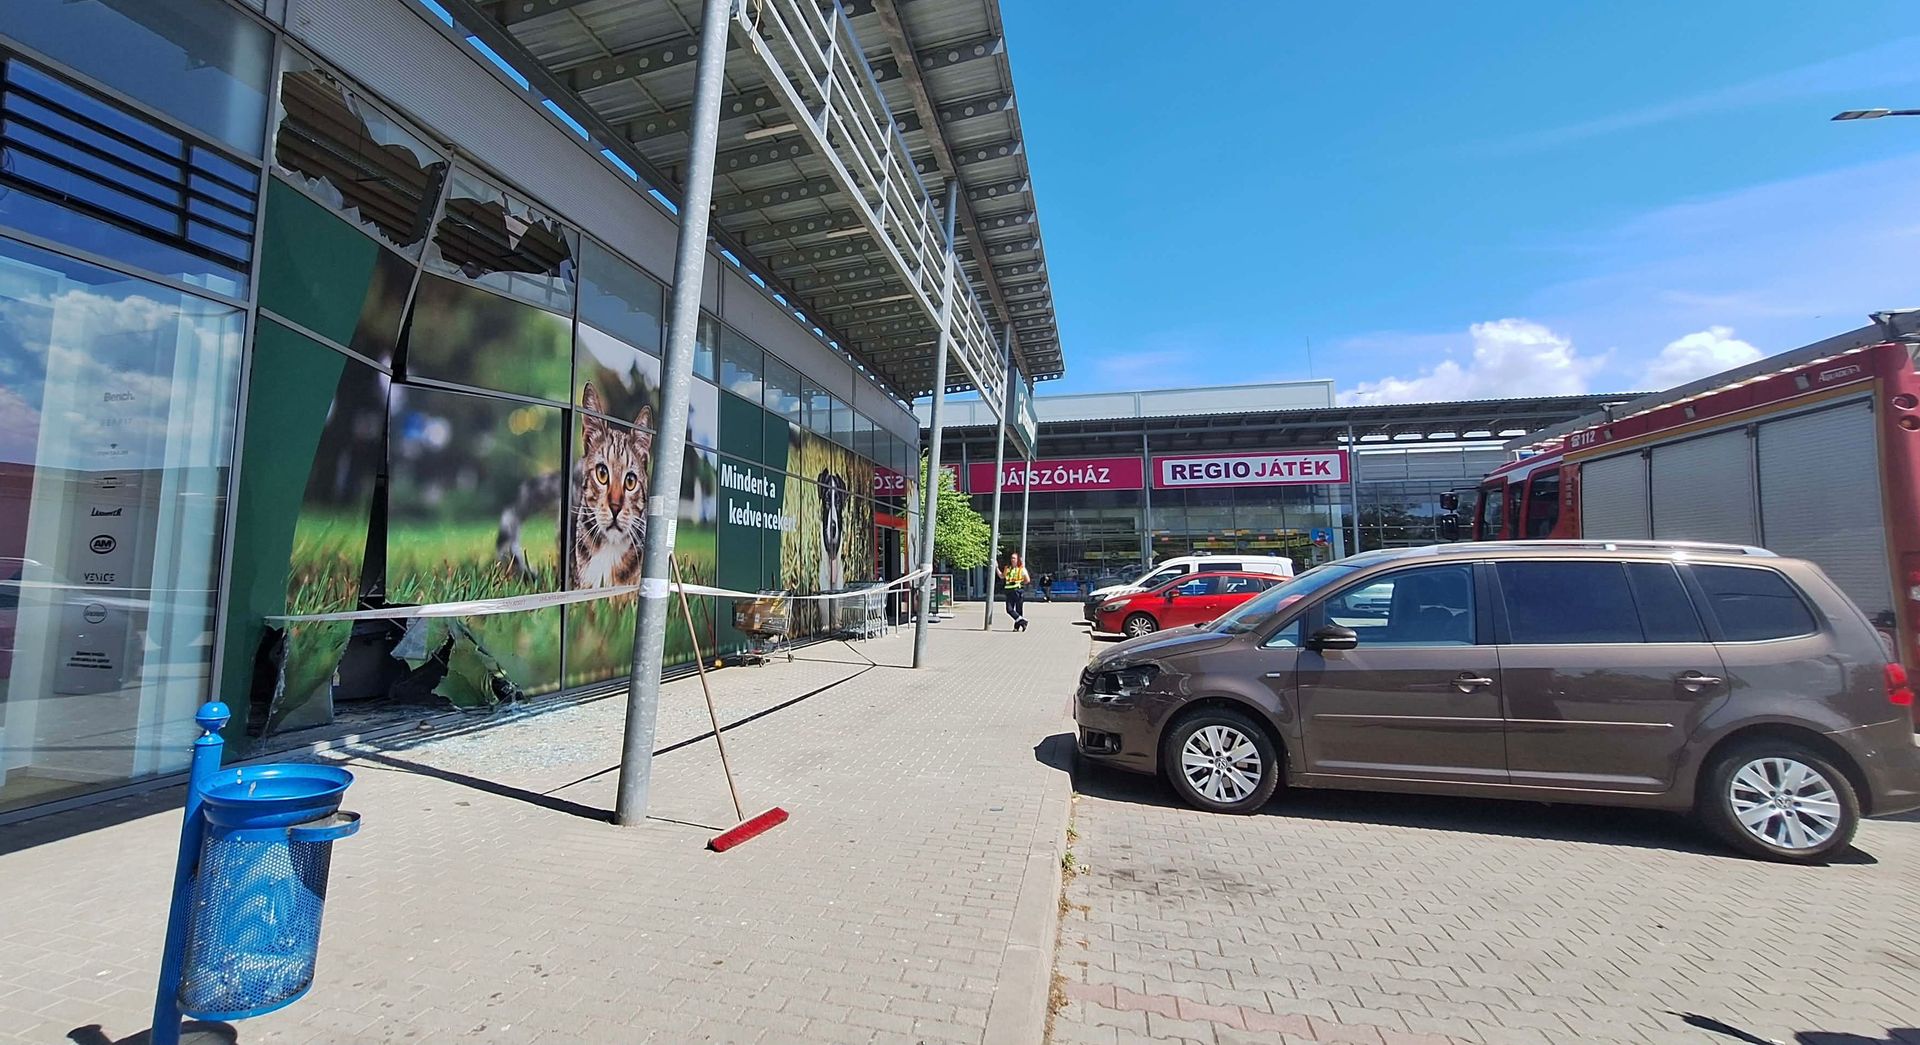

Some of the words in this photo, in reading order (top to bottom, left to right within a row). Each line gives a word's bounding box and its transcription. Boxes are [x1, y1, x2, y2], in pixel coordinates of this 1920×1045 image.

[1581, 430, 1596, 445] 112
[1001, 464, 1111, 487] JÁTSZÓHÁZ
[1171, 461, 1250, 480] REGIO
[1254, 458, 1332, 477] JÁTÉK
[720, 463, 769, 497] Mindent
[769, 482, 776, 499] a
